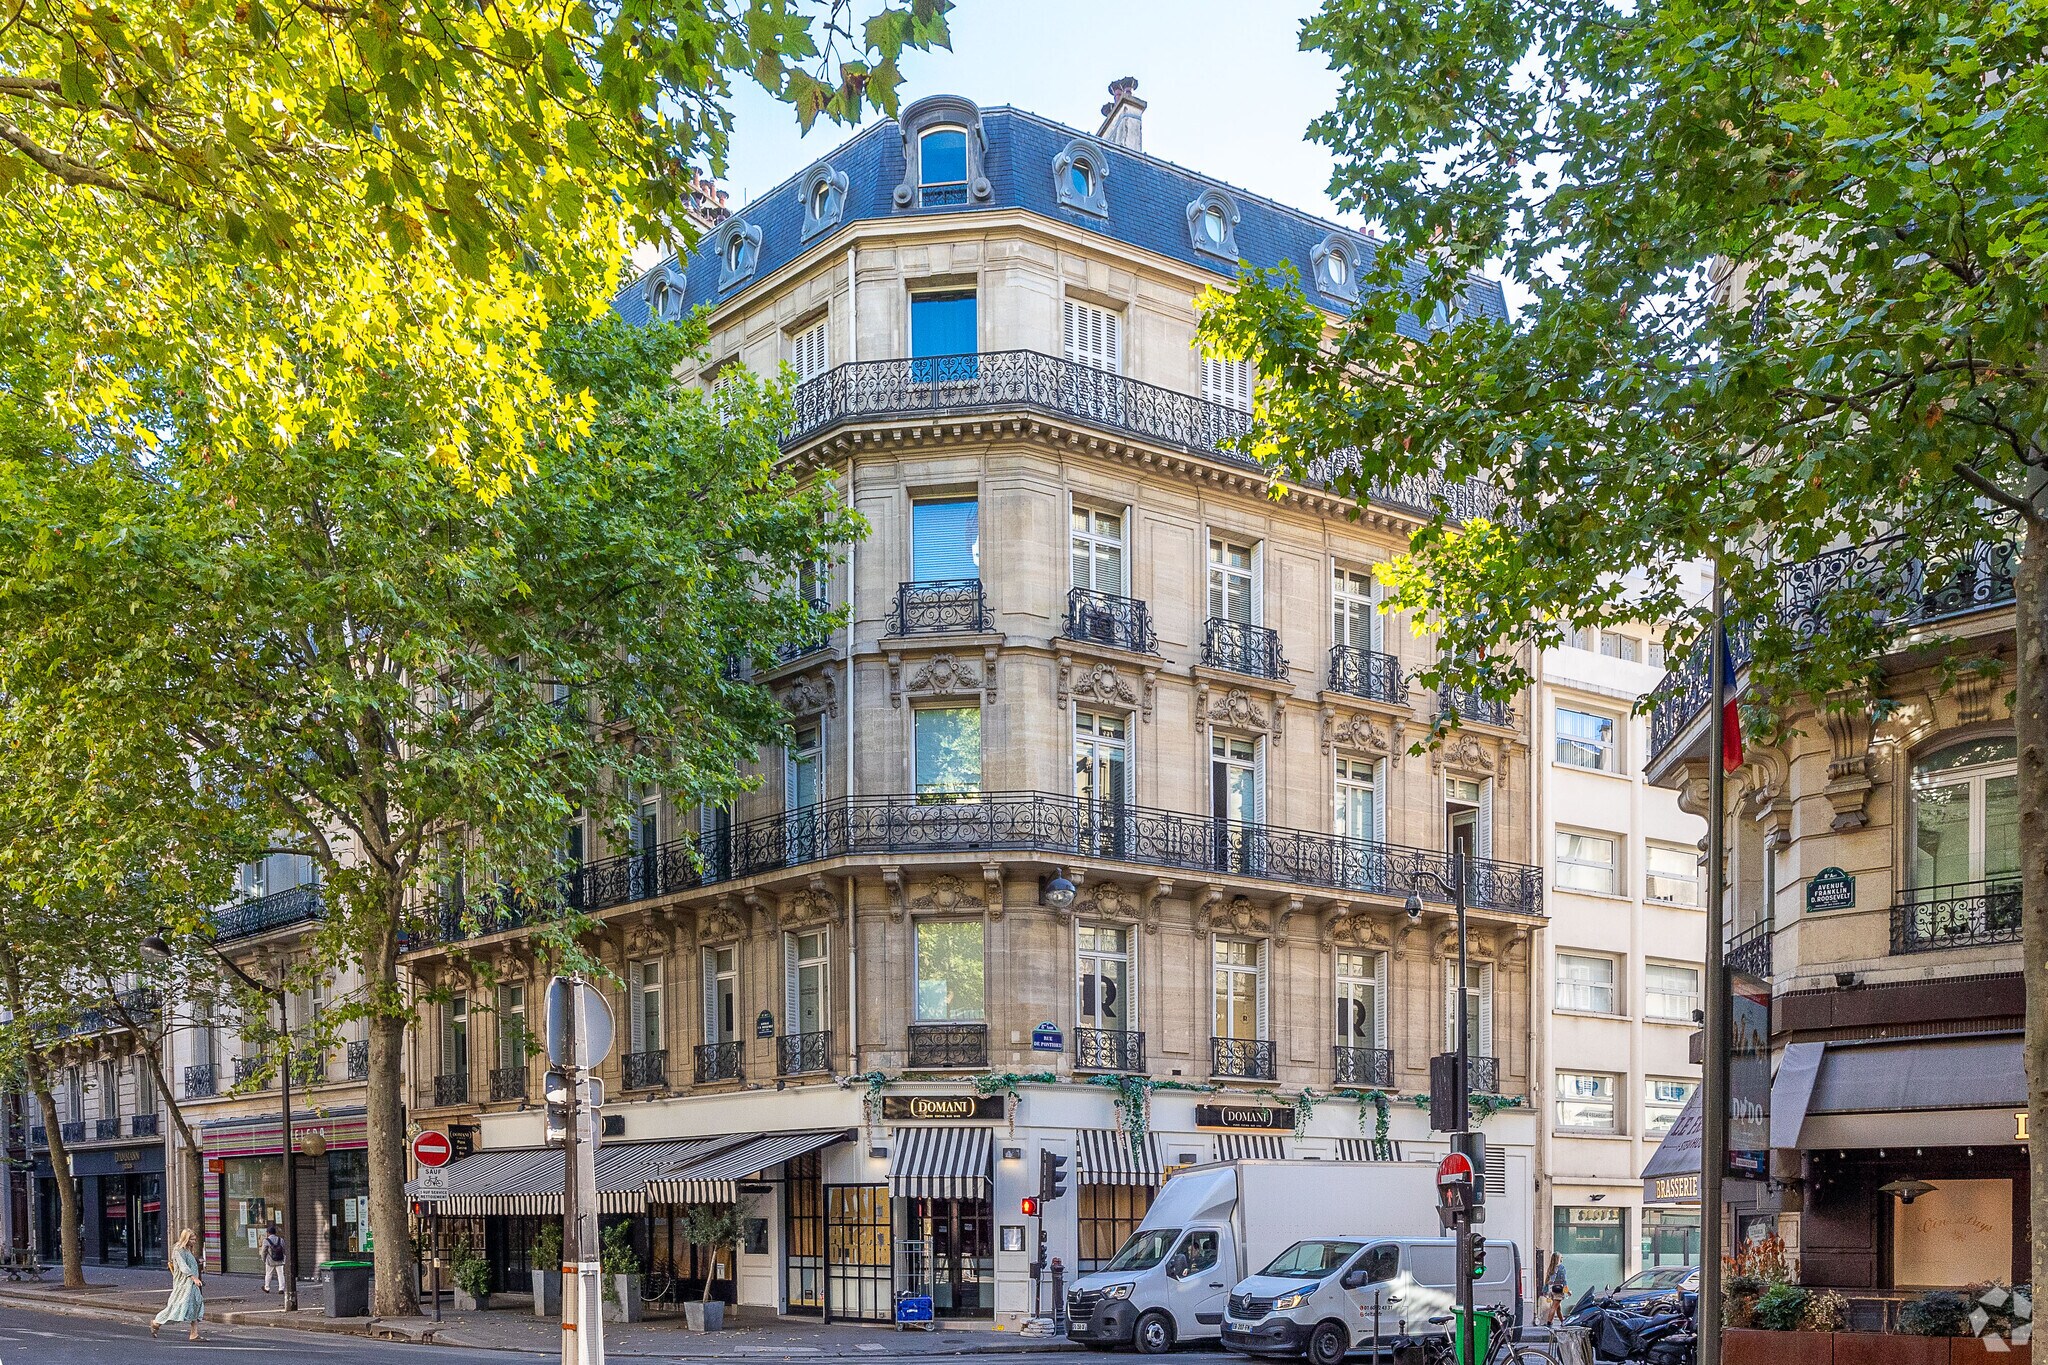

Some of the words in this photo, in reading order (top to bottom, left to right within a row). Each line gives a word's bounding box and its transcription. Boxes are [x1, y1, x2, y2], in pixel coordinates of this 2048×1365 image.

[1818, 882, 1844, 890] AVENUE
[1814, 888, 1847, 896] FRANKLIN
[1656, 1177, 1698, 1199] BRASSERIE
